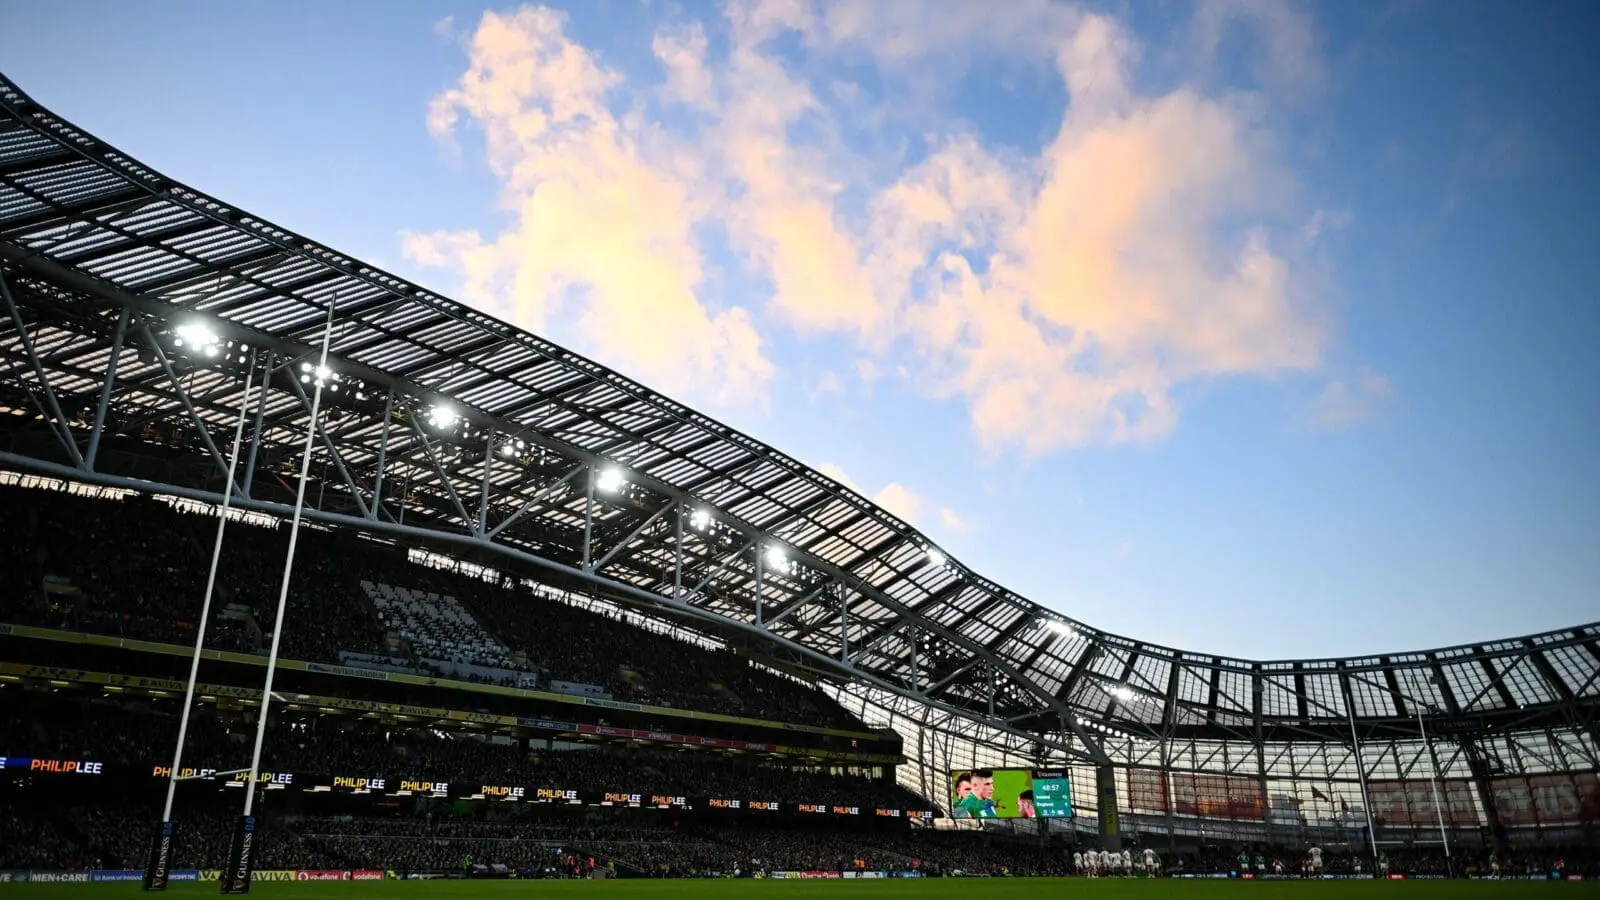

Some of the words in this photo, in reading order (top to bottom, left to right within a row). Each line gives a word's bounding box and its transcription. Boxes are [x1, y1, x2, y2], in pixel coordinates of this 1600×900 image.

[31, 758, 103, 774] PHILIPLEE
[152, 766, 216, 780] PHIPLEE
[235, 771, 293, 784] PHLIPLEE
[334, 776, 386, 789] PHILIPLEE
[400, 780, 449, 793] PHILIPLEE
[482, 785, 525, 797] PHILIPLEE
[537, 788, 577, 799] PHILIPLEE
[604, 792, 642, 803] PHILIPLEE
[652, 795, 686, 805] PHILIPLEE
[709, 798, 741, 809] PHILIPLEE
[749, 800, 779, 811] PHILIPLEE
[156, 835, 171, 878] GUINNESS
[237, 832, 253, 879] GUINNESS
[251, 871, 291, 881] AVIVA
[352, 872, 381, 881] vodafone
